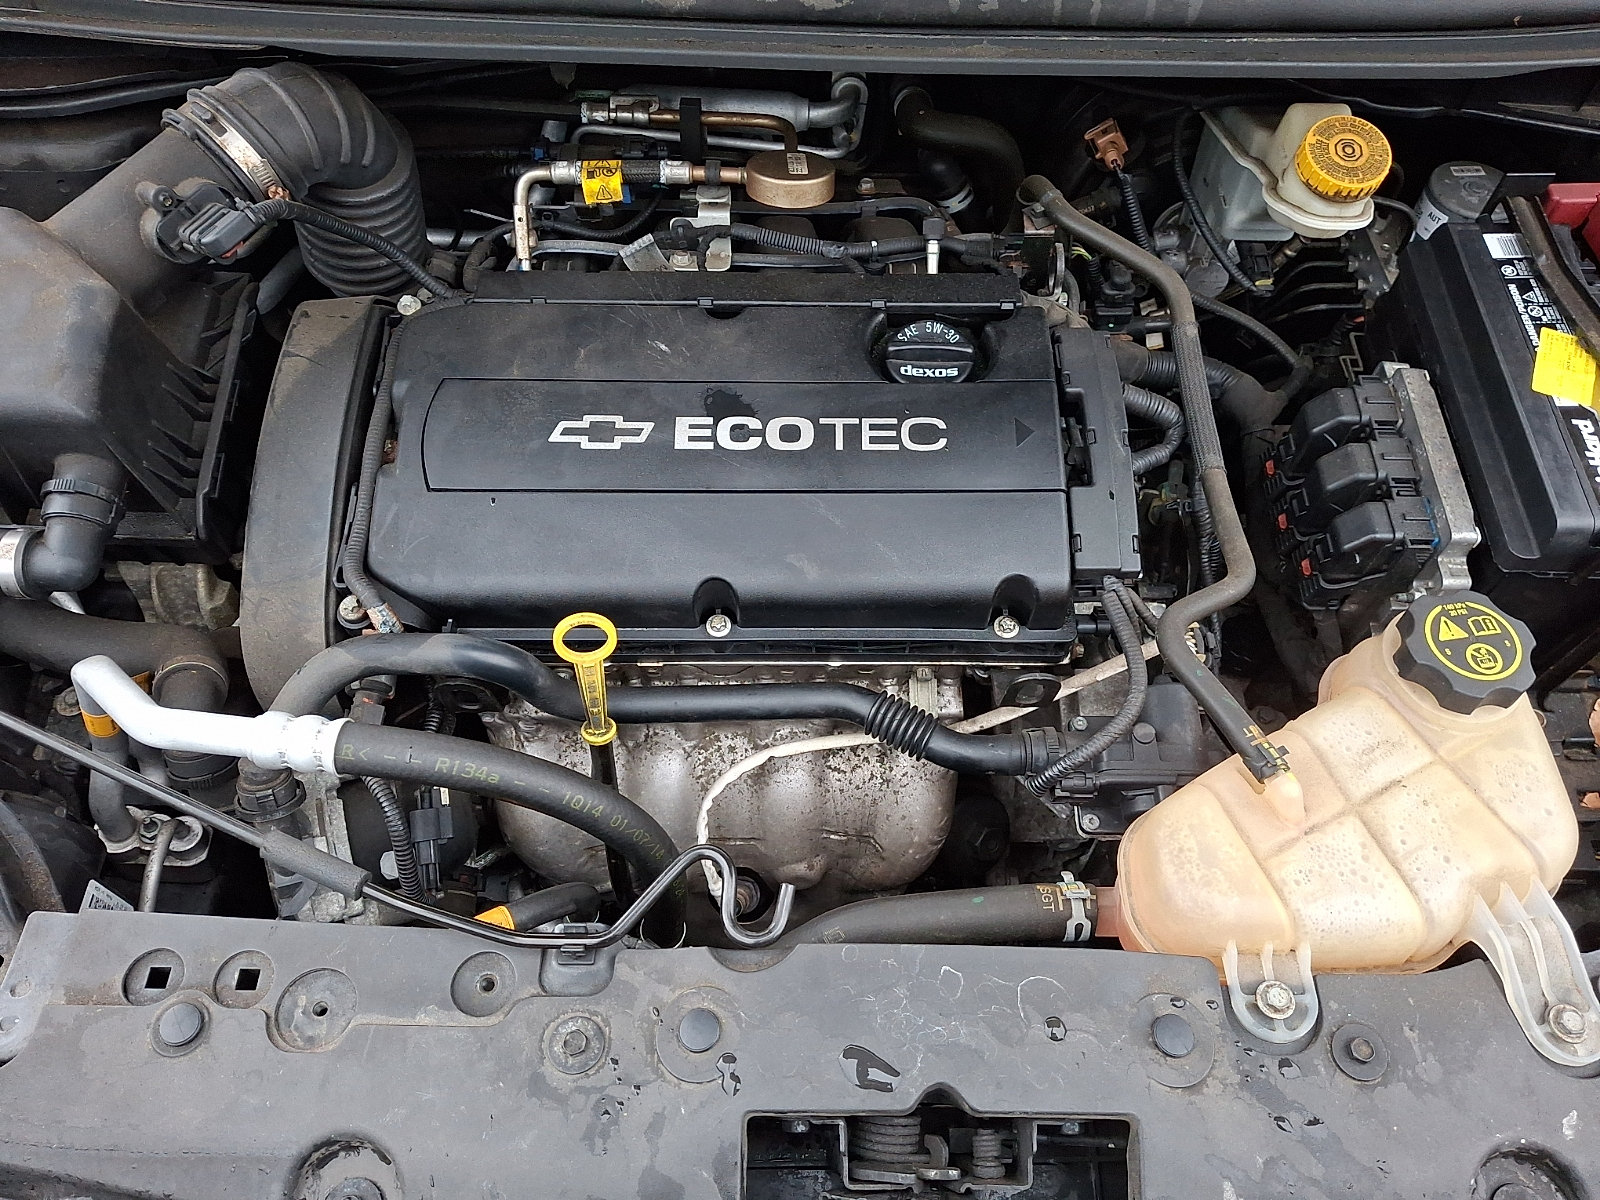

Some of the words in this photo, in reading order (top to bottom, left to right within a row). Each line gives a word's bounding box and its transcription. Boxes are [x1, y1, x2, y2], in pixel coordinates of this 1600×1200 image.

[897, 323, 919, 342] SAE
[925, 321, 960, 343] 5W-30
[900, 364, 959, 378] dexos
[673, 416, 949, 452] ECOTEC
[434, 757, 501, 784] R134a
